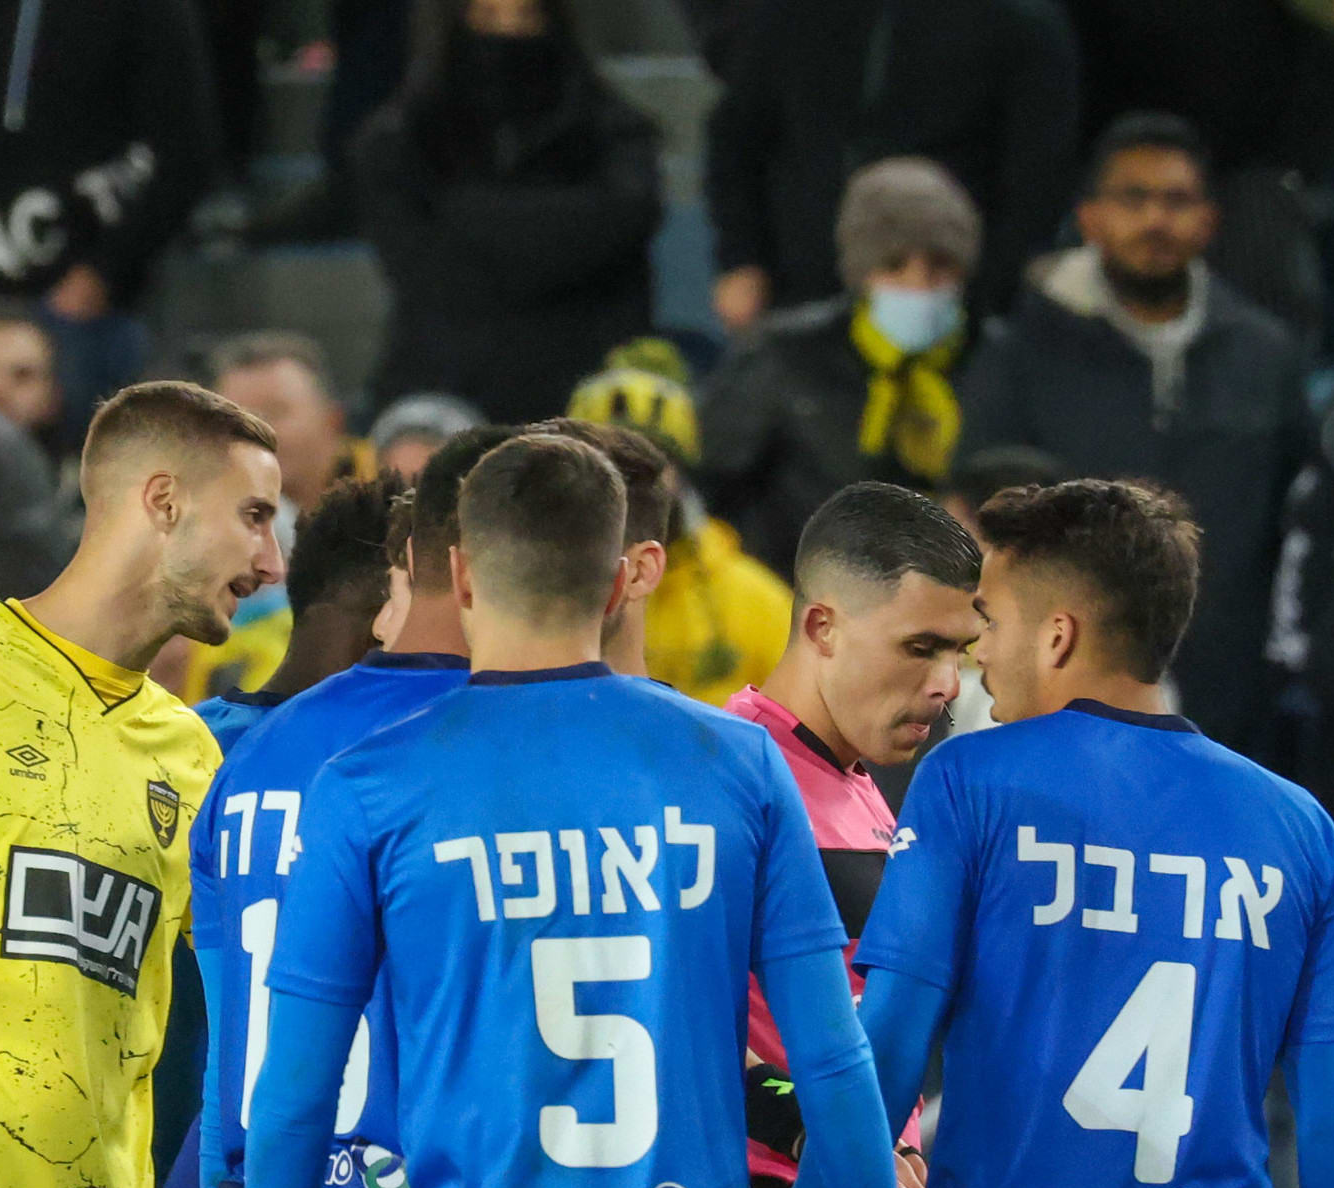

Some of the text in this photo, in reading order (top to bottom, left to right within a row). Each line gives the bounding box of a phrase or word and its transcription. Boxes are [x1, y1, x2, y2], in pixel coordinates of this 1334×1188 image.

[9, 767, 47, 781] umbro
[433, 806, 716, 922] לאופר
[1017, 826, 1284, 950] ארבל
[530, 934, 659, 1168] 5
[1063, 961, 1197, 1185] 4
